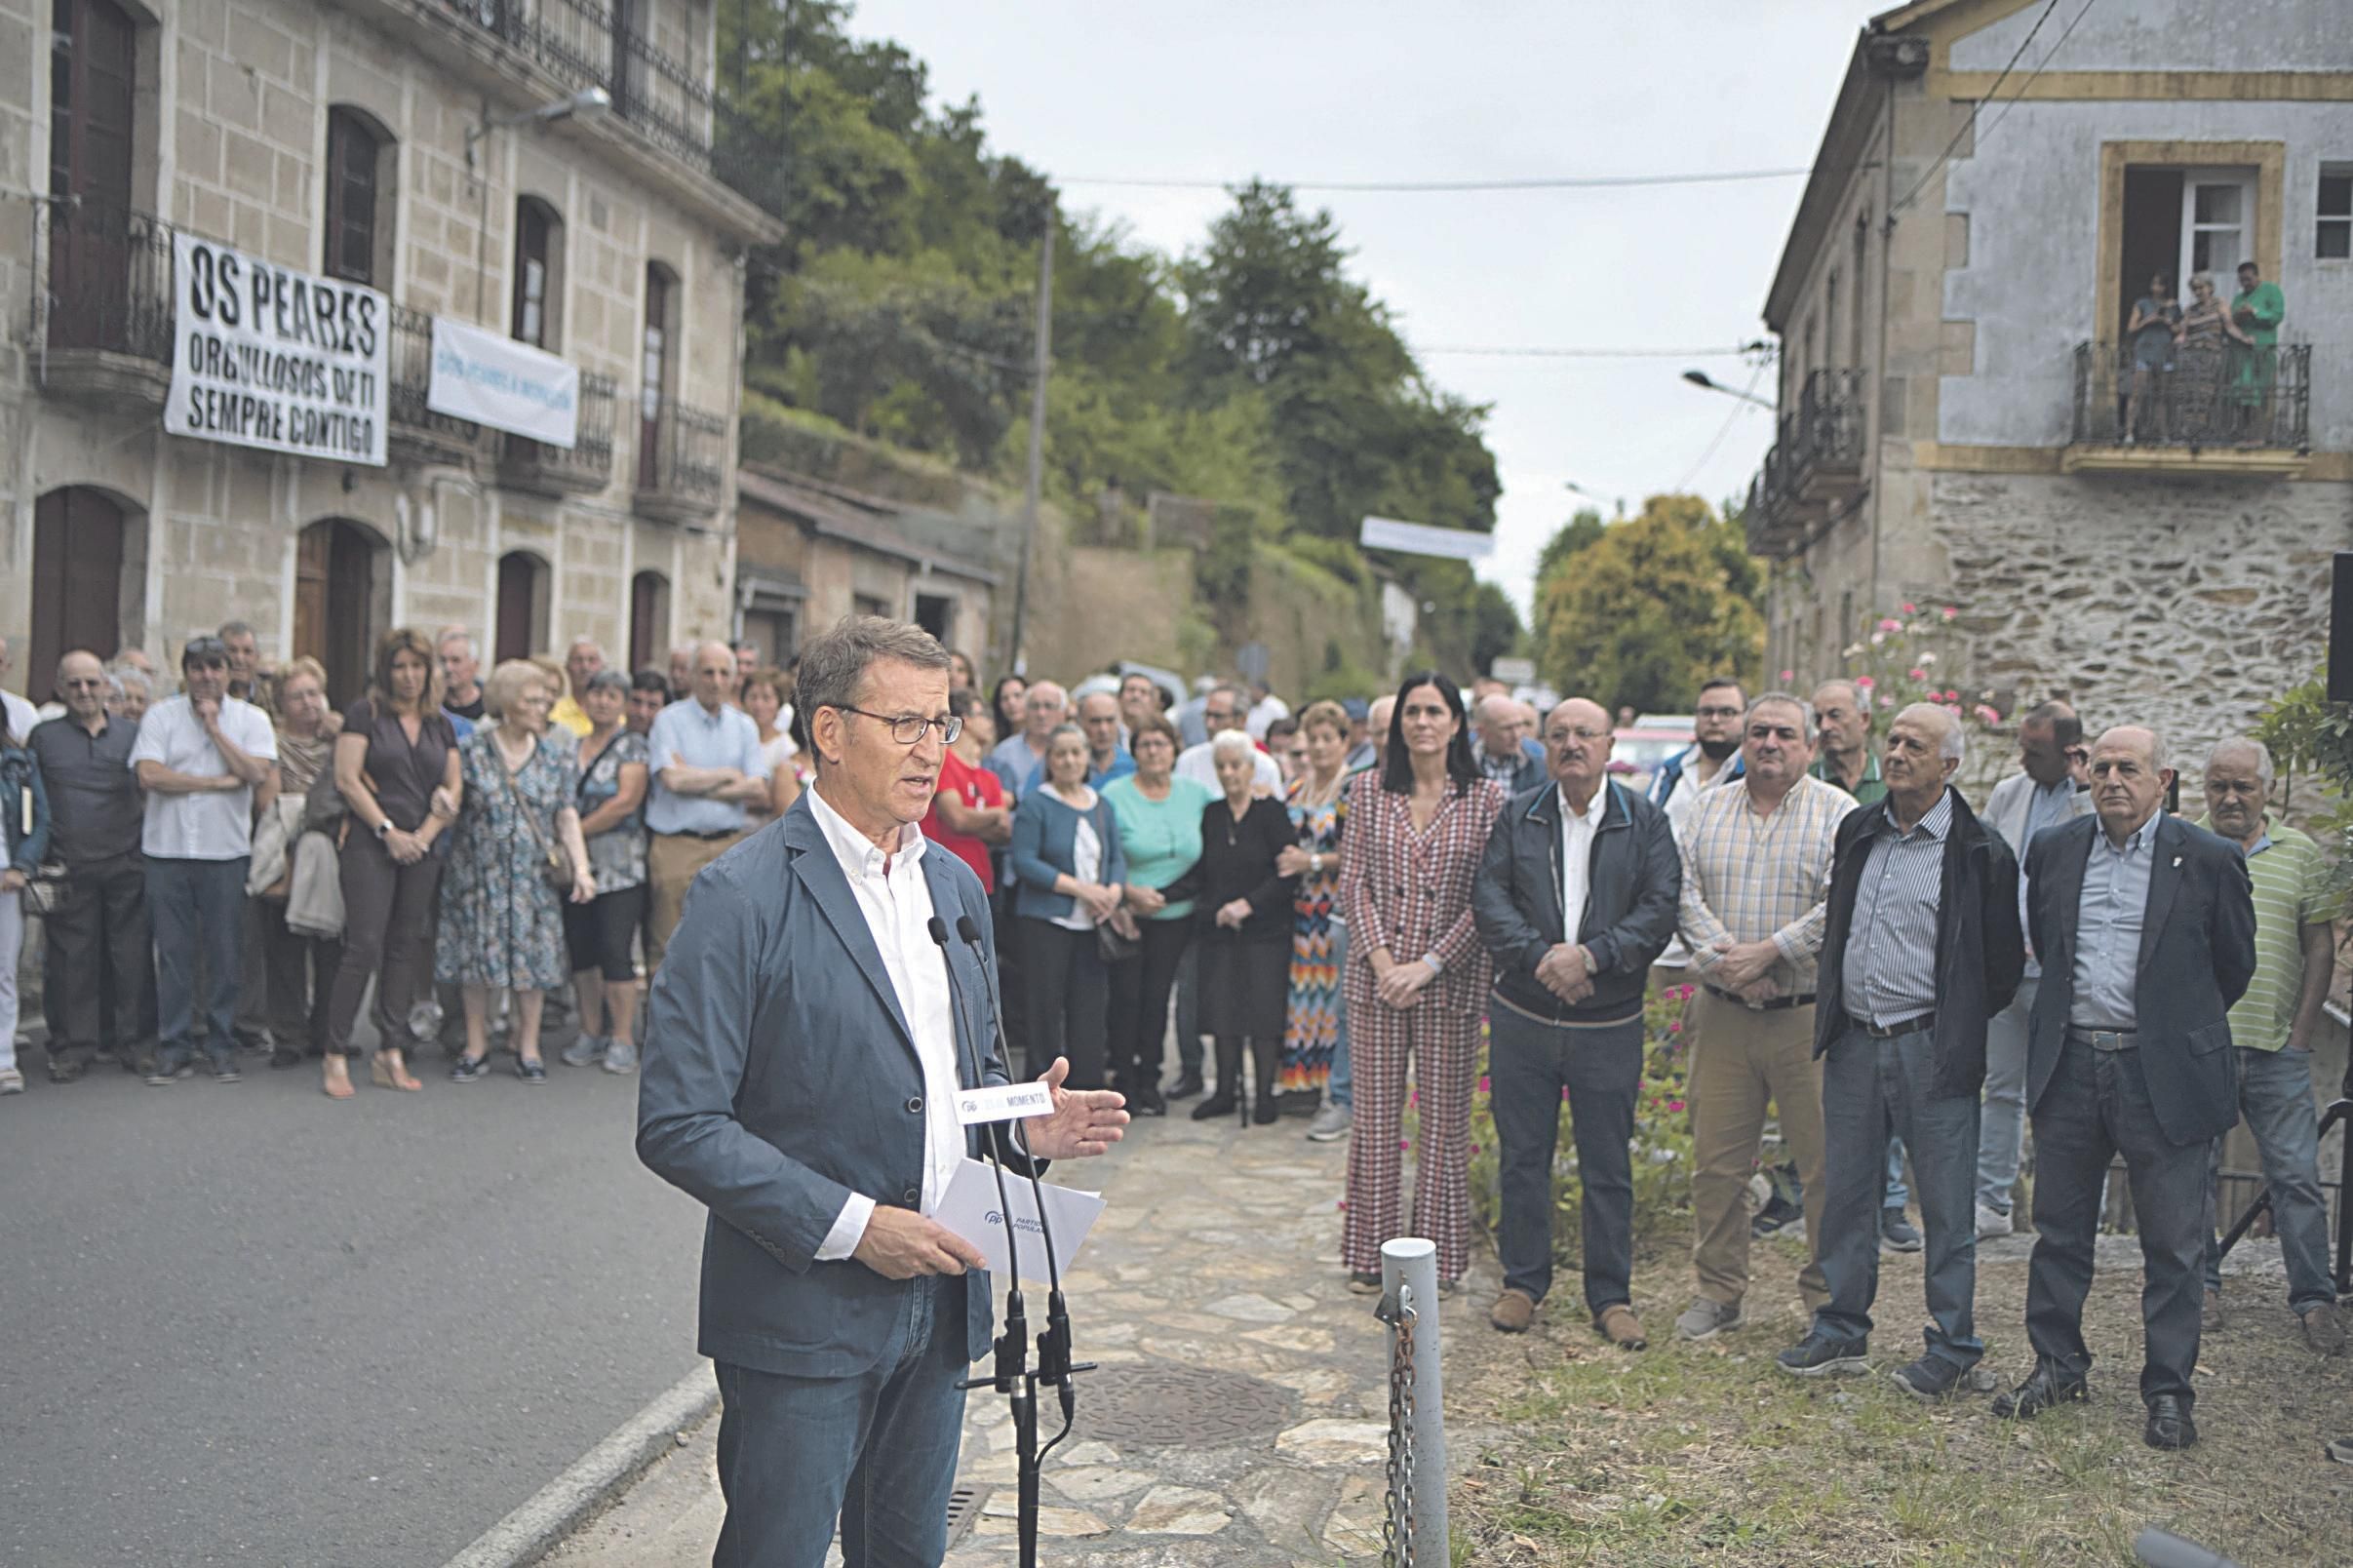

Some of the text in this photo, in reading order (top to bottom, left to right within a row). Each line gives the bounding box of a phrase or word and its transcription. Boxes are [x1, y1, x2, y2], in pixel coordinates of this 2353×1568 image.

[191, 245, 376, 357] OS PEARES
[189, 332, 374, 409] ORGULLOSOS DE TI
[187, 385, 373, 455] SEMPRE CONTIGO
[1006, 1092, 1046, 1108] MOMENTO
[1015, 1217, 1042, 1227] PARTID
